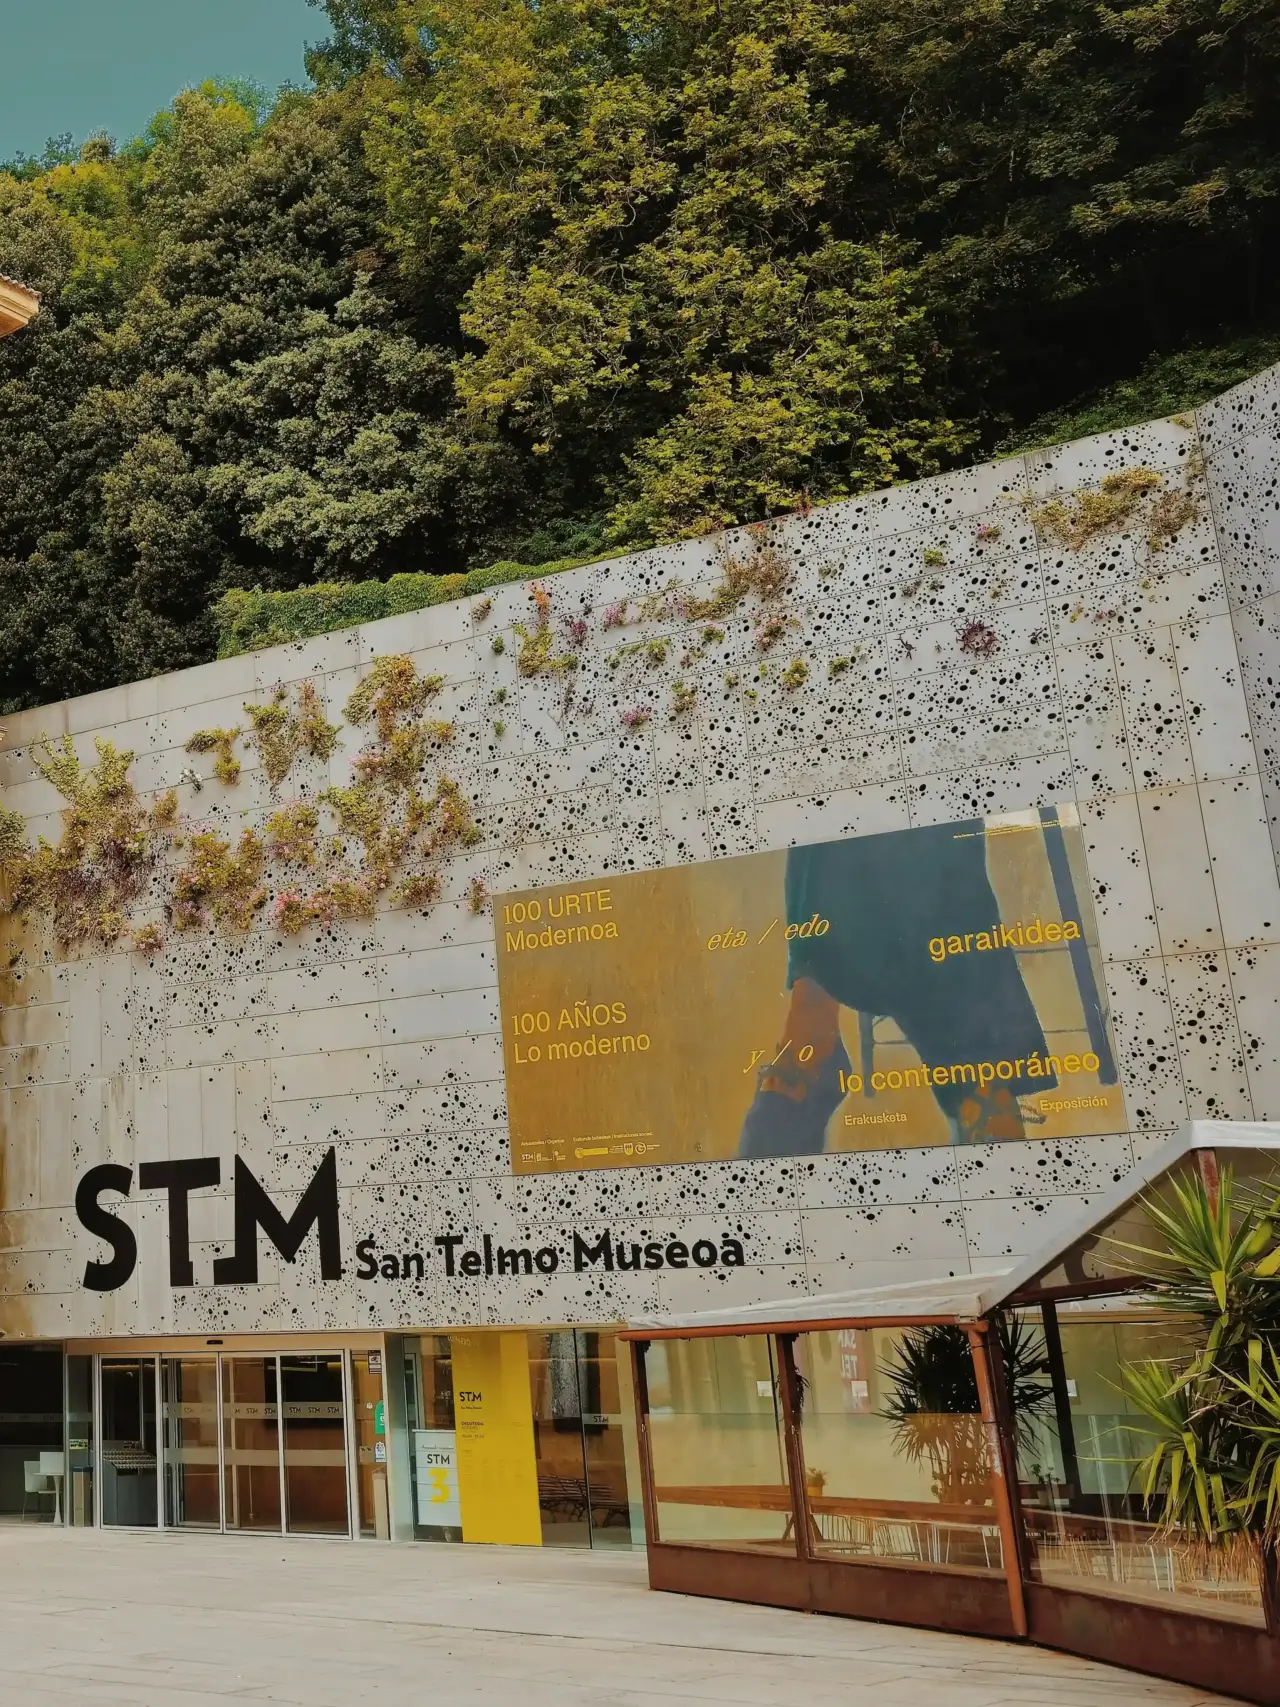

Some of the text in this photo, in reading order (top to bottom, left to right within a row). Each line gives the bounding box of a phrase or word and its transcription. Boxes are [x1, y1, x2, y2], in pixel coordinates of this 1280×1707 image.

[502, 888, 613, 925] 100 URTE
[505, 920, 619, 952] Modernoa
[707, 913, 830, 950] eta / edo
[928, 919, 1081, 962] garaikidea
[511, 1000, 627, 1036] 100 AÑOS
[513, 1033, 651, 1064] Lo moderno
[742, 1039, 814, 1074] y / o
[838, 1051, 1100, 1093] lo contemporáneo
[844, 1111, 908, 1126] Erakusketa
[1039, 1095, 1108, 1114] Exposición
[75, 1146, 342, 1292] STM
[355, 1228, 745, 1280] San Telmo Museoa
[308, 1406, 320, 1414] STM
[327, 1406, 339, 1414] STM
[459, 1391, 482, 1402] STM
[593, 1415, 609, 1423] STM
[426, 1453, 450, 1464] STM
[428, 1468, 451, 1504] 3
